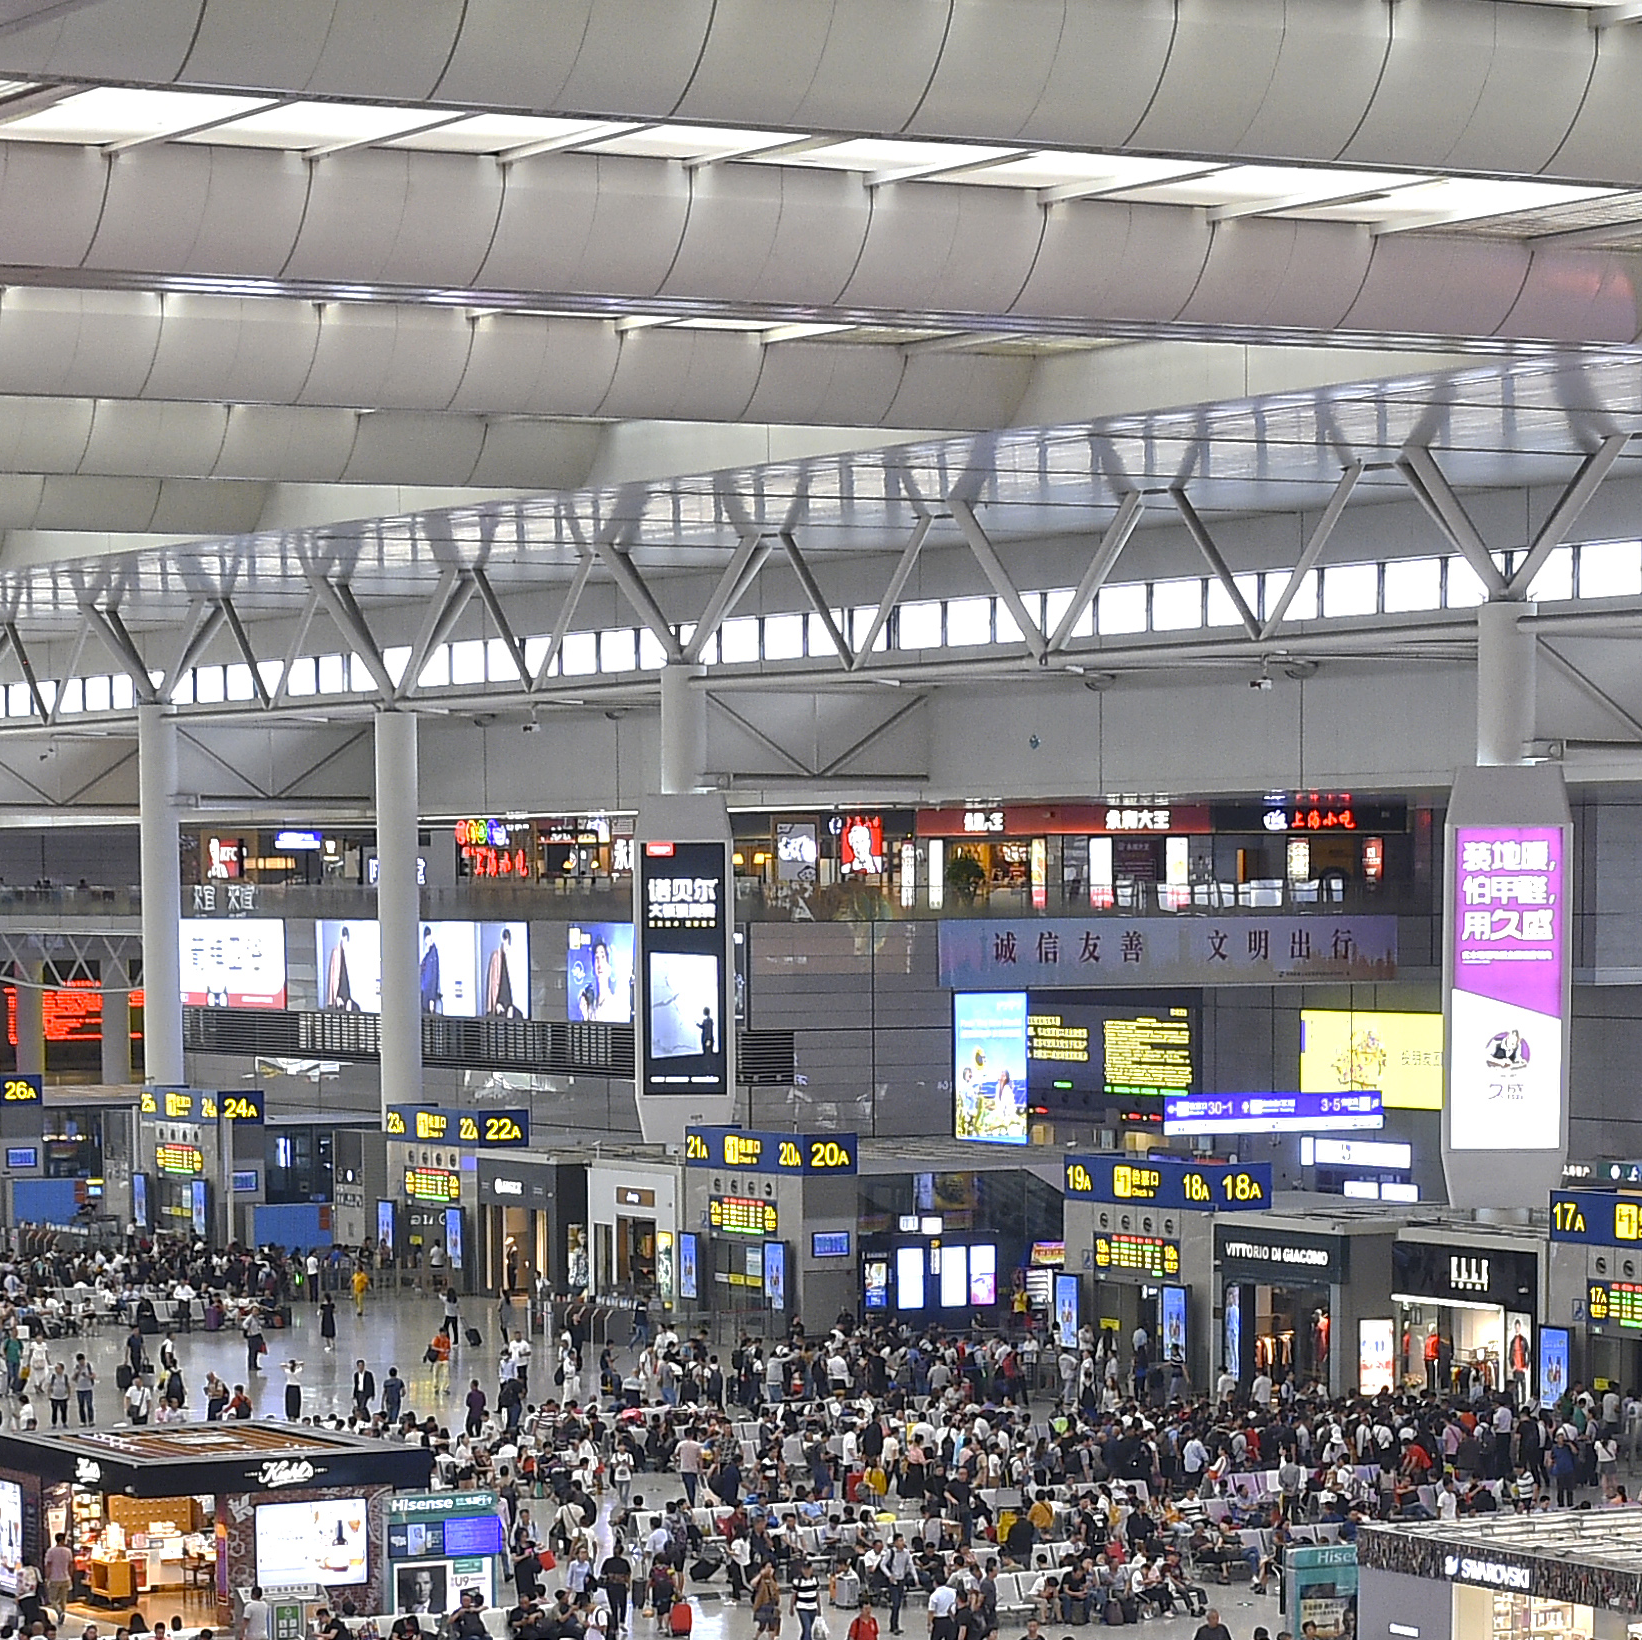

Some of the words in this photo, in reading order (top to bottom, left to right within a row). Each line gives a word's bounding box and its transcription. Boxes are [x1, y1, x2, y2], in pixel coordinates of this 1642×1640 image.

[648, 878, 718, 902] 诺贝尔
[1461, 910, 1554, 941] 用久盛
[993, 931, 1144, 964] 诚信友善
[1208, 929, 1353, 961] 文明出行
[5, 1081, 37, 1100] 26A
[225, 1098, 257, 1118] 24A
[459, 1118, 478, 1140] 22A
[486, 1118, 521, 1140] 22A
[687, 1136, 708, 1159] 21A
[779, 1142, 801, 1167] 20A
[811, 1142, 850, 1167] 20A
[1067, 1165, 1091, 1192] 19A
[1182, 1173, 1210, 1201] 18A
[1222, 1174, 1262, 1201] 18A
[1553, 1202, 1585, 1232] 17A
[1226, 1242, 1269, 1260] VITTORIO
[1272, 1247, 1282, 1261] DI
[1283, 1248, 1329, 1266] GIACOMO
[258, 1460, 314, 1484] Kiehl's
[392, 1498, 453, 1512] Hisense
[455, 1577, 468, 1587] U9
[1462, 1560, 1530, 1588] SWAROVSKI
